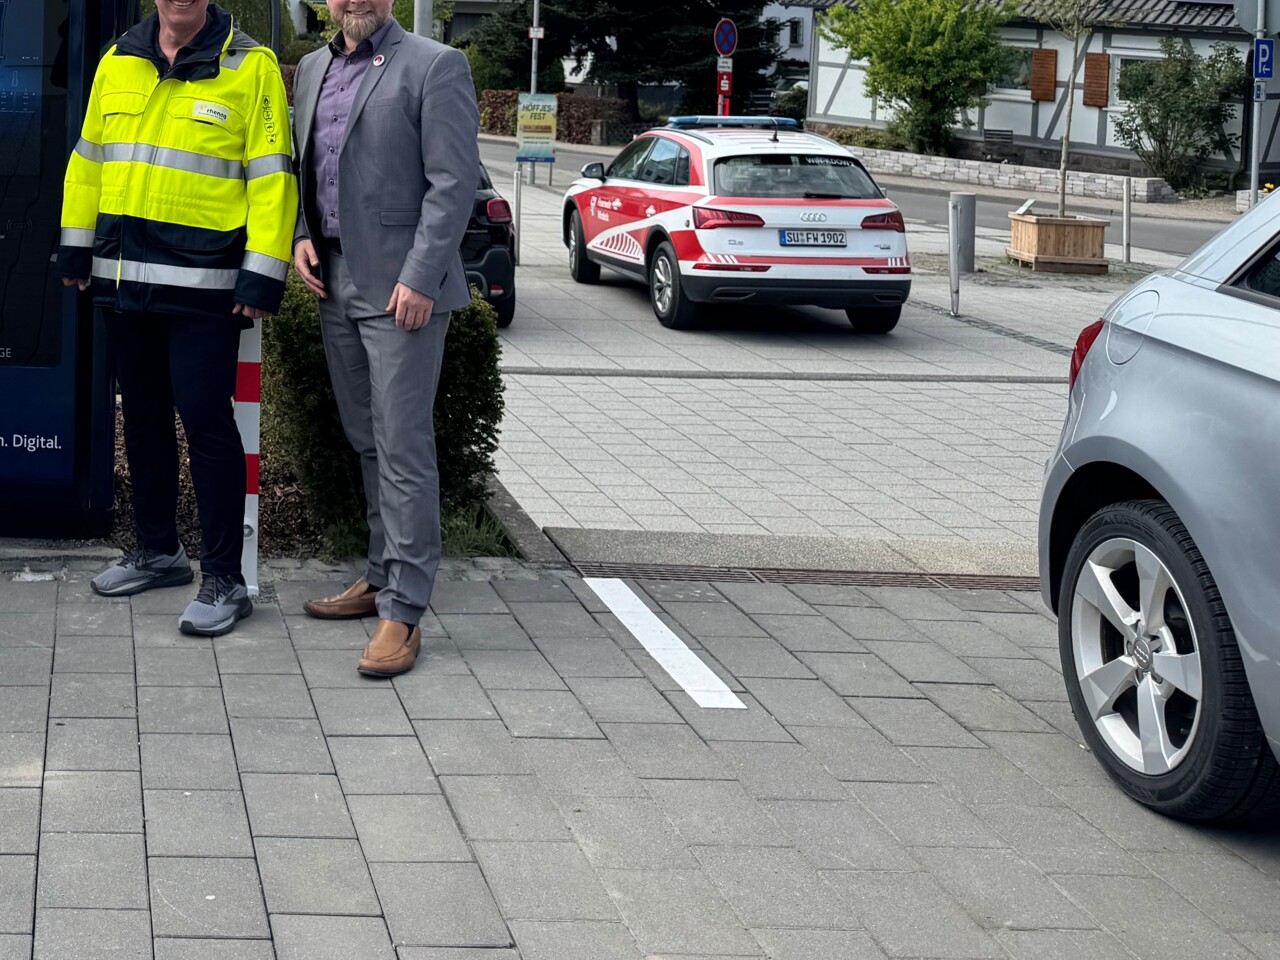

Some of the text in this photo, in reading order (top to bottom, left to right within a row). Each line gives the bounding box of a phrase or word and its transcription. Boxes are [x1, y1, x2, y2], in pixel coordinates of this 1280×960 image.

[1258, 44, 1270, 73] P
[206, 108, 227, 120] rhenag
[530, 112, 547, 120] FEST
[786, 232, 845, 244] SU FW 1902
[13, 434, 62, 452] Digital.
